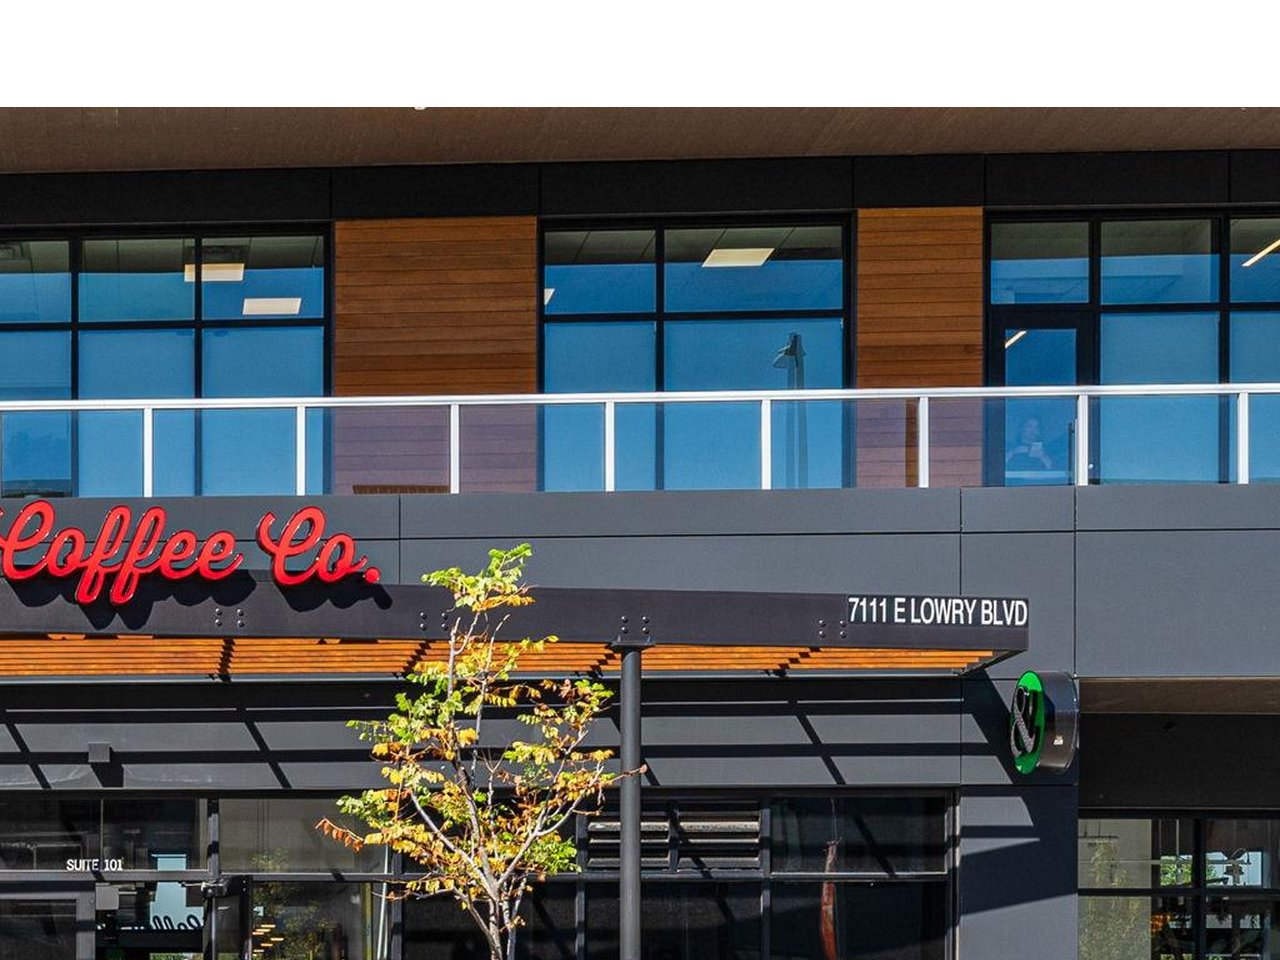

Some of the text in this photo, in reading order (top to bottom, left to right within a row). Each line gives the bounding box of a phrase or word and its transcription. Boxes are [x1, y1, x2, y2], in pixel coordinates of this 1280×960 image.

[257, 506, 381, 586] Co.
[848, 597, 1028, 626] 7111 E LOWRY BLVD
[66, 858, 123, 871] SUITE 101
